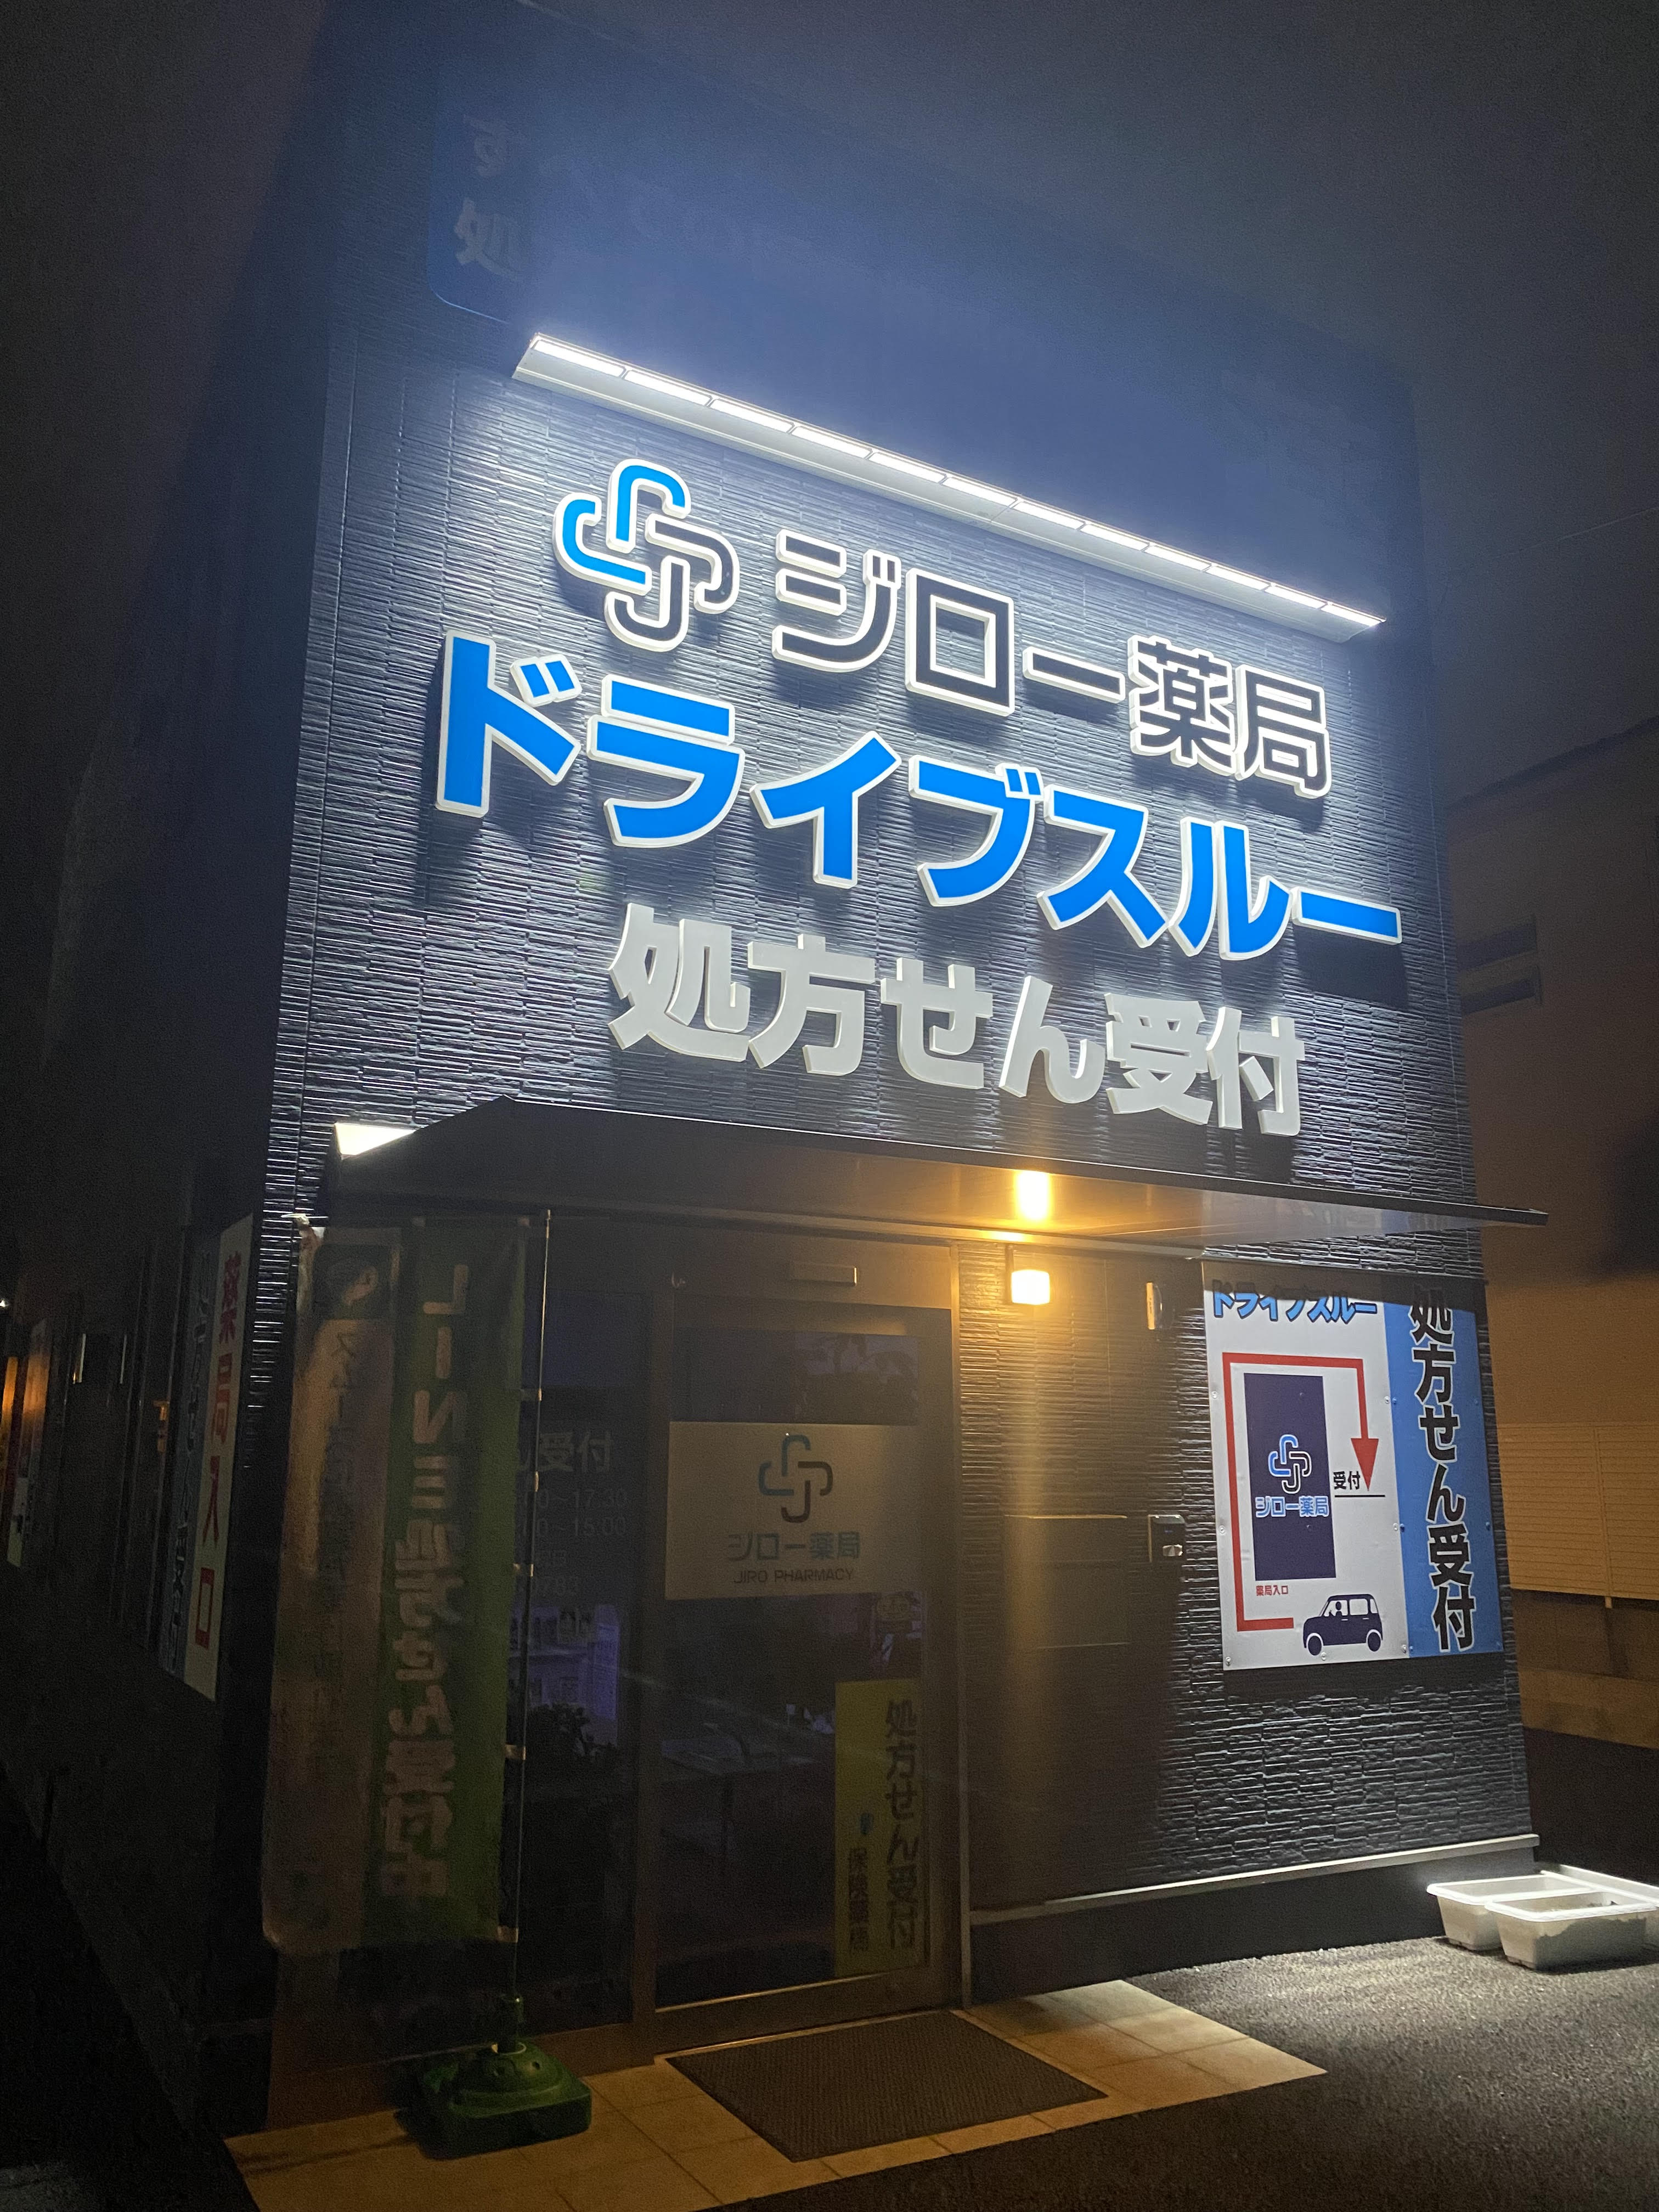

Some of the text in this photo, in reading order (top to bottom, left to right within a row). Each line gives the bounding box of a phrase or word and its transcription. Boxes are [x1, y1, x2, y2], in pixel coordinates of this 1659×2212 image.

[772, 528, 1331, 800] ジロー薬局
[436, 629, 1403, 960] ドライブスルー
[608, 902, 1306, 1137] 処方せん受付
[1255, 1496, 1329, 1517] ジロー薬局
[1333, 1471, 1361, 1490] 受付
[1408, 1286, 1477, 1654] 処方せん受付
[733, 1567, 854, 1584] JIRO PHARMACY
[1256, 1585, 1289, 1596] 薬局入口
